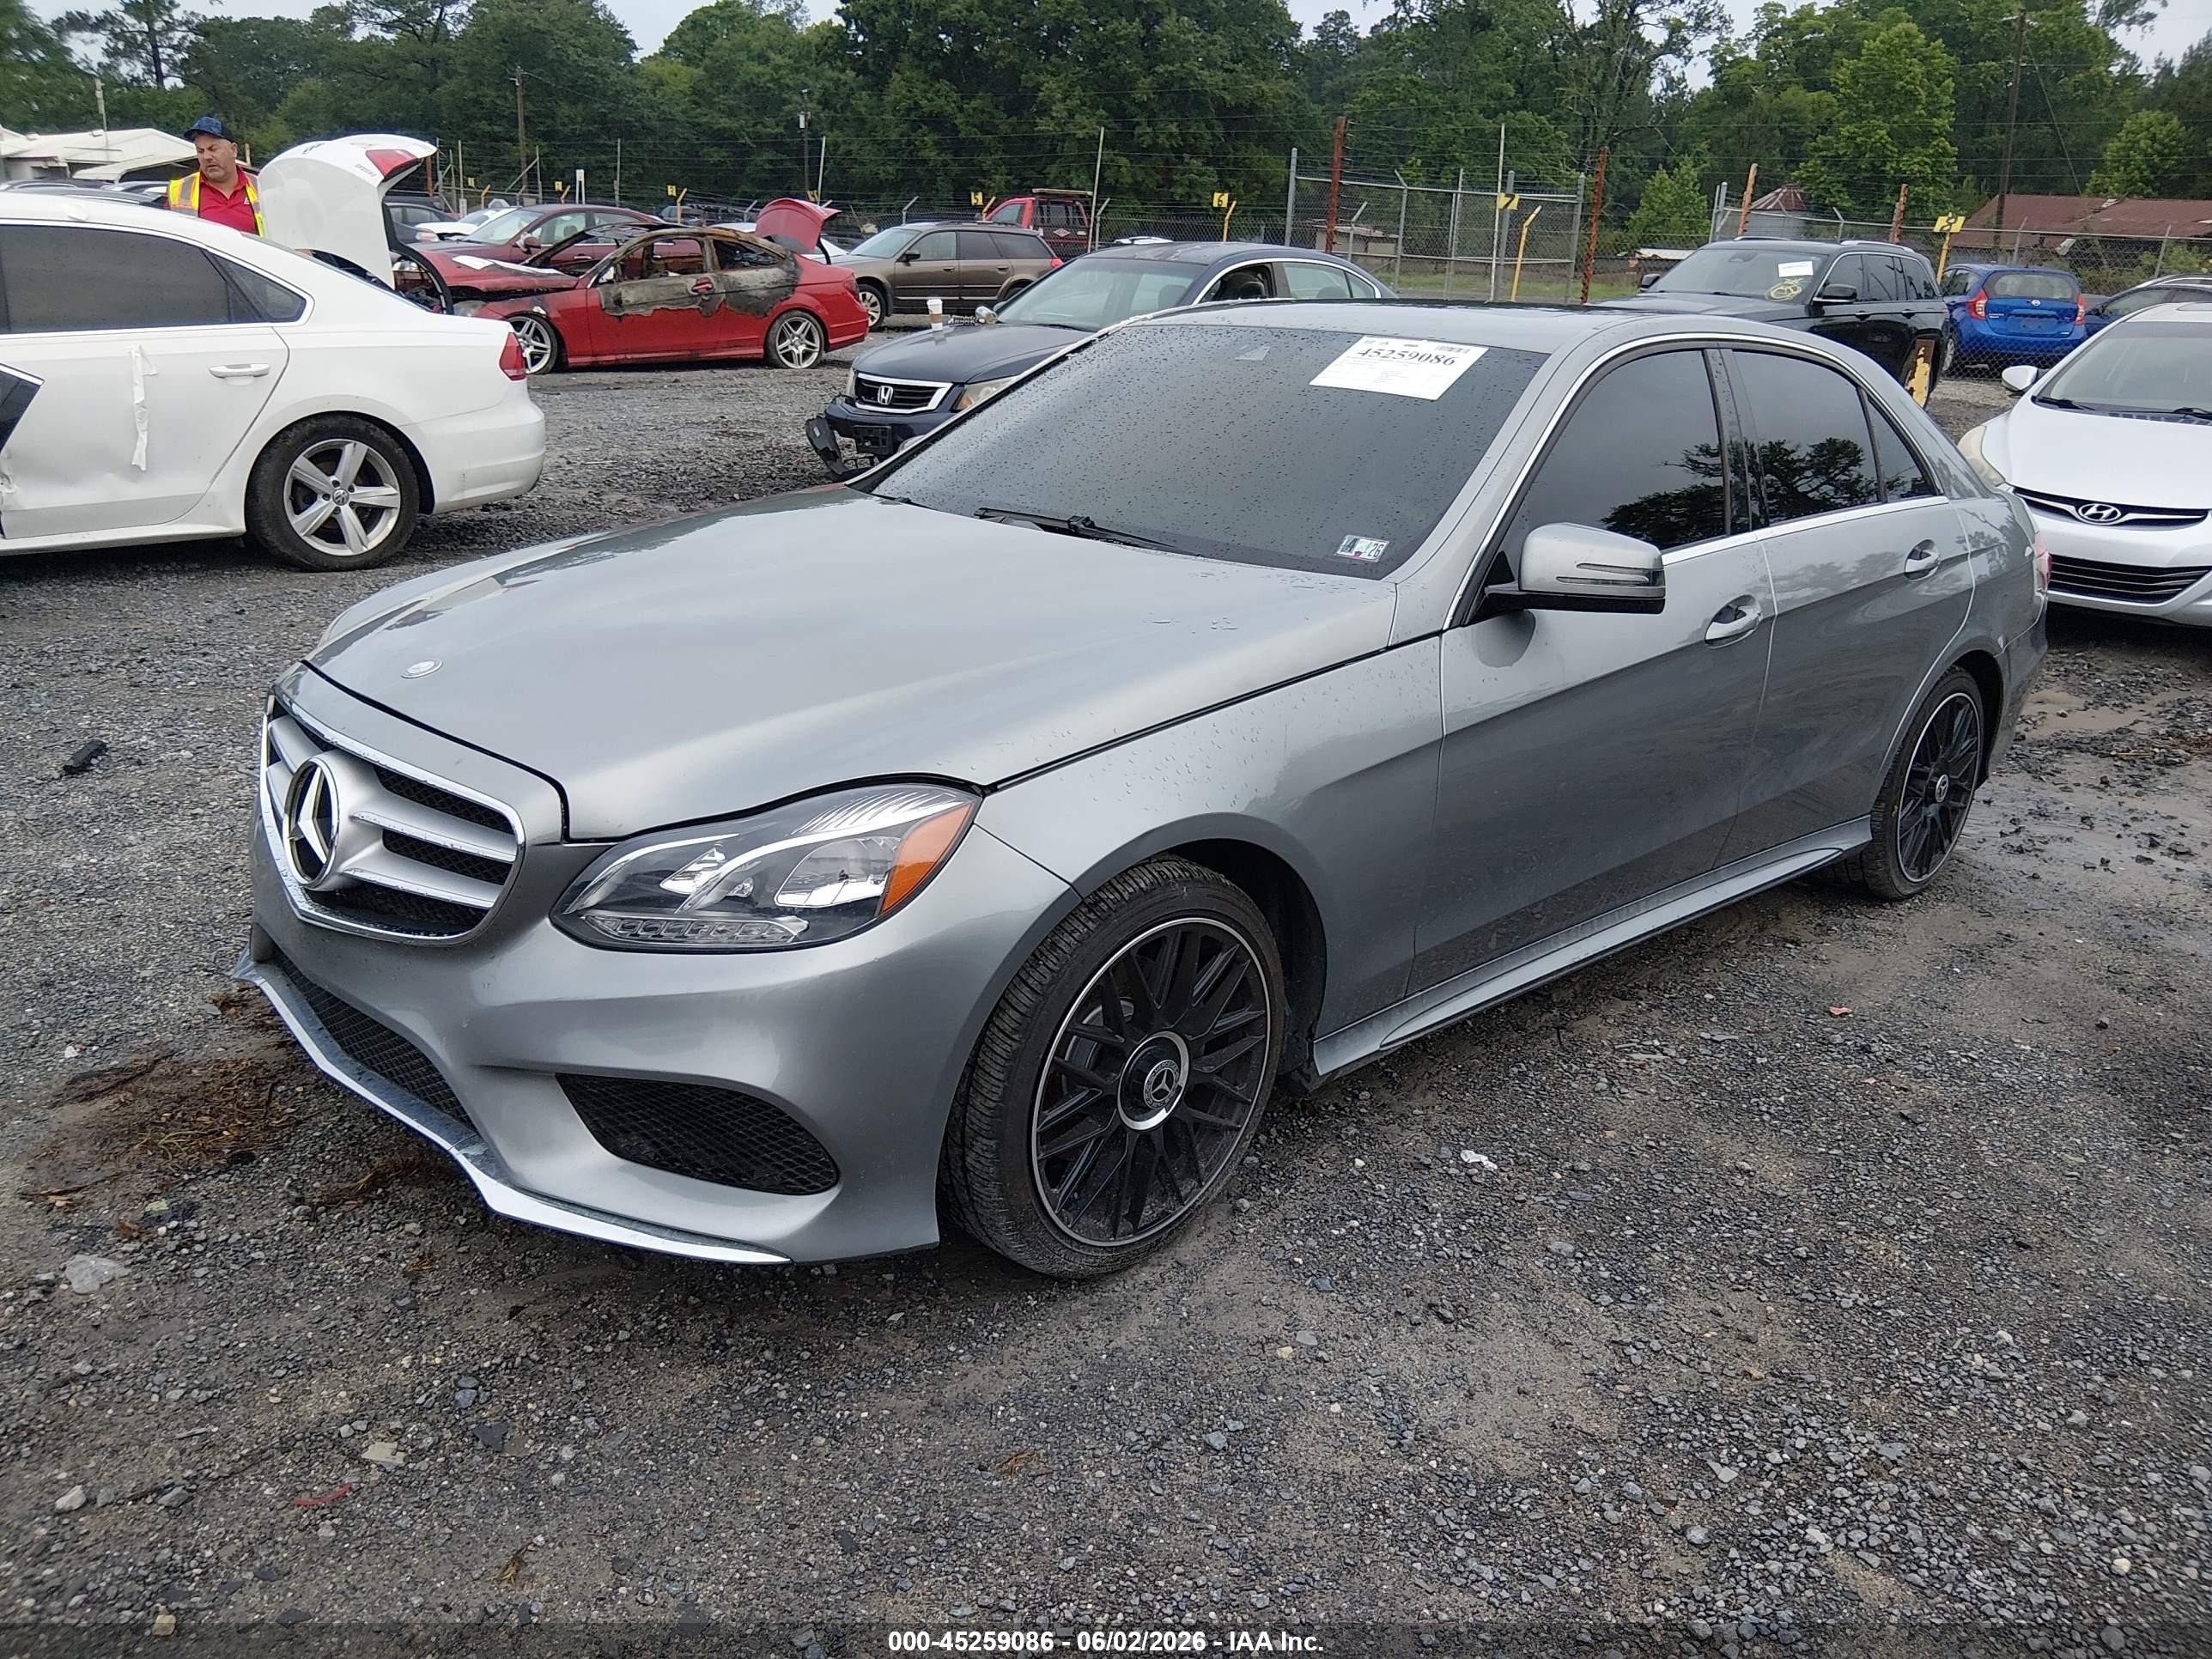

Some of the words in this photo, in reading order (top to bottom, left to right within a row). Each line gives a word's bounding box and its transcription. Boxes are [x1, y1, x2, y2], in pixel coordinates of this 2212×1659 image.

[973, 192, 979, 204] 5
[1217, 193, 1224, 206] 6
[1504, 193, 1515, 209] 7
[1940, 212, 1957, 231] 8
[1358, 349, 1457, 366] 45259086
